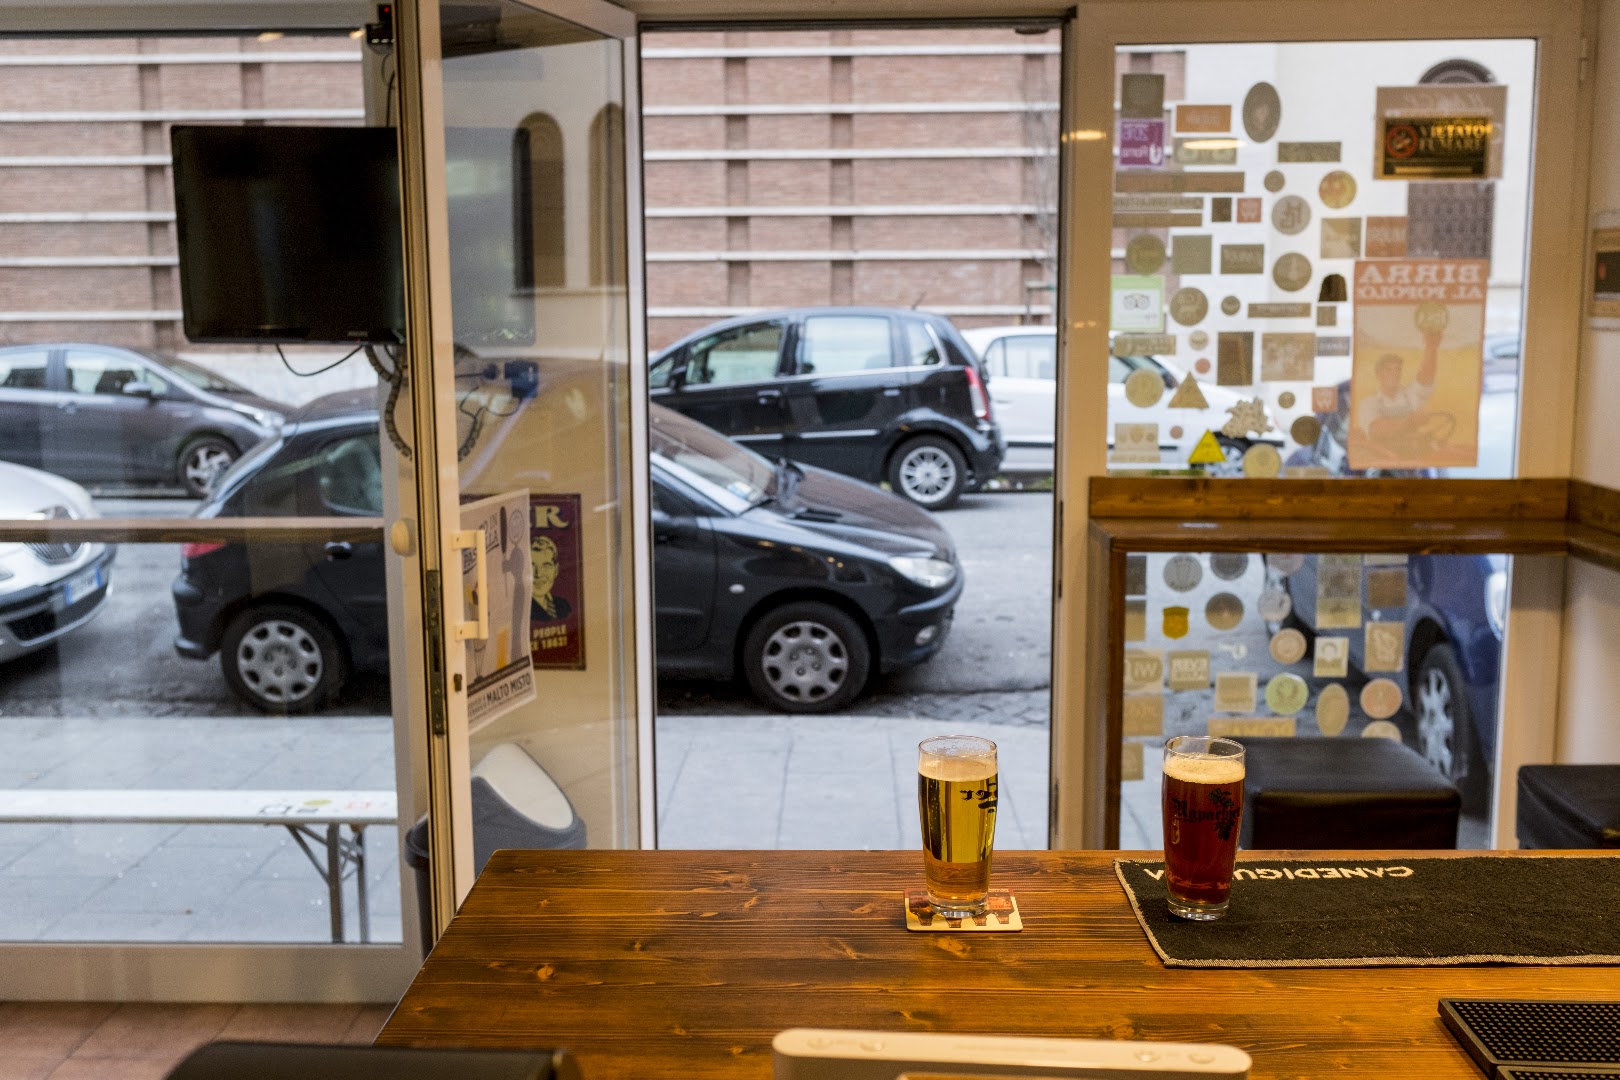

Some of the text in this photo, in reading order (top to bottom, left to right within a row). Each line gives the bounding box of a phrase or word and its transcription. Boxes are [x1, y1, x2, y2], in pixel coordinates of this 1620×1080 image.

[532, 624, 567, 640] PEOPLE
[486, 672, 532, 702] MALTO MISTO
